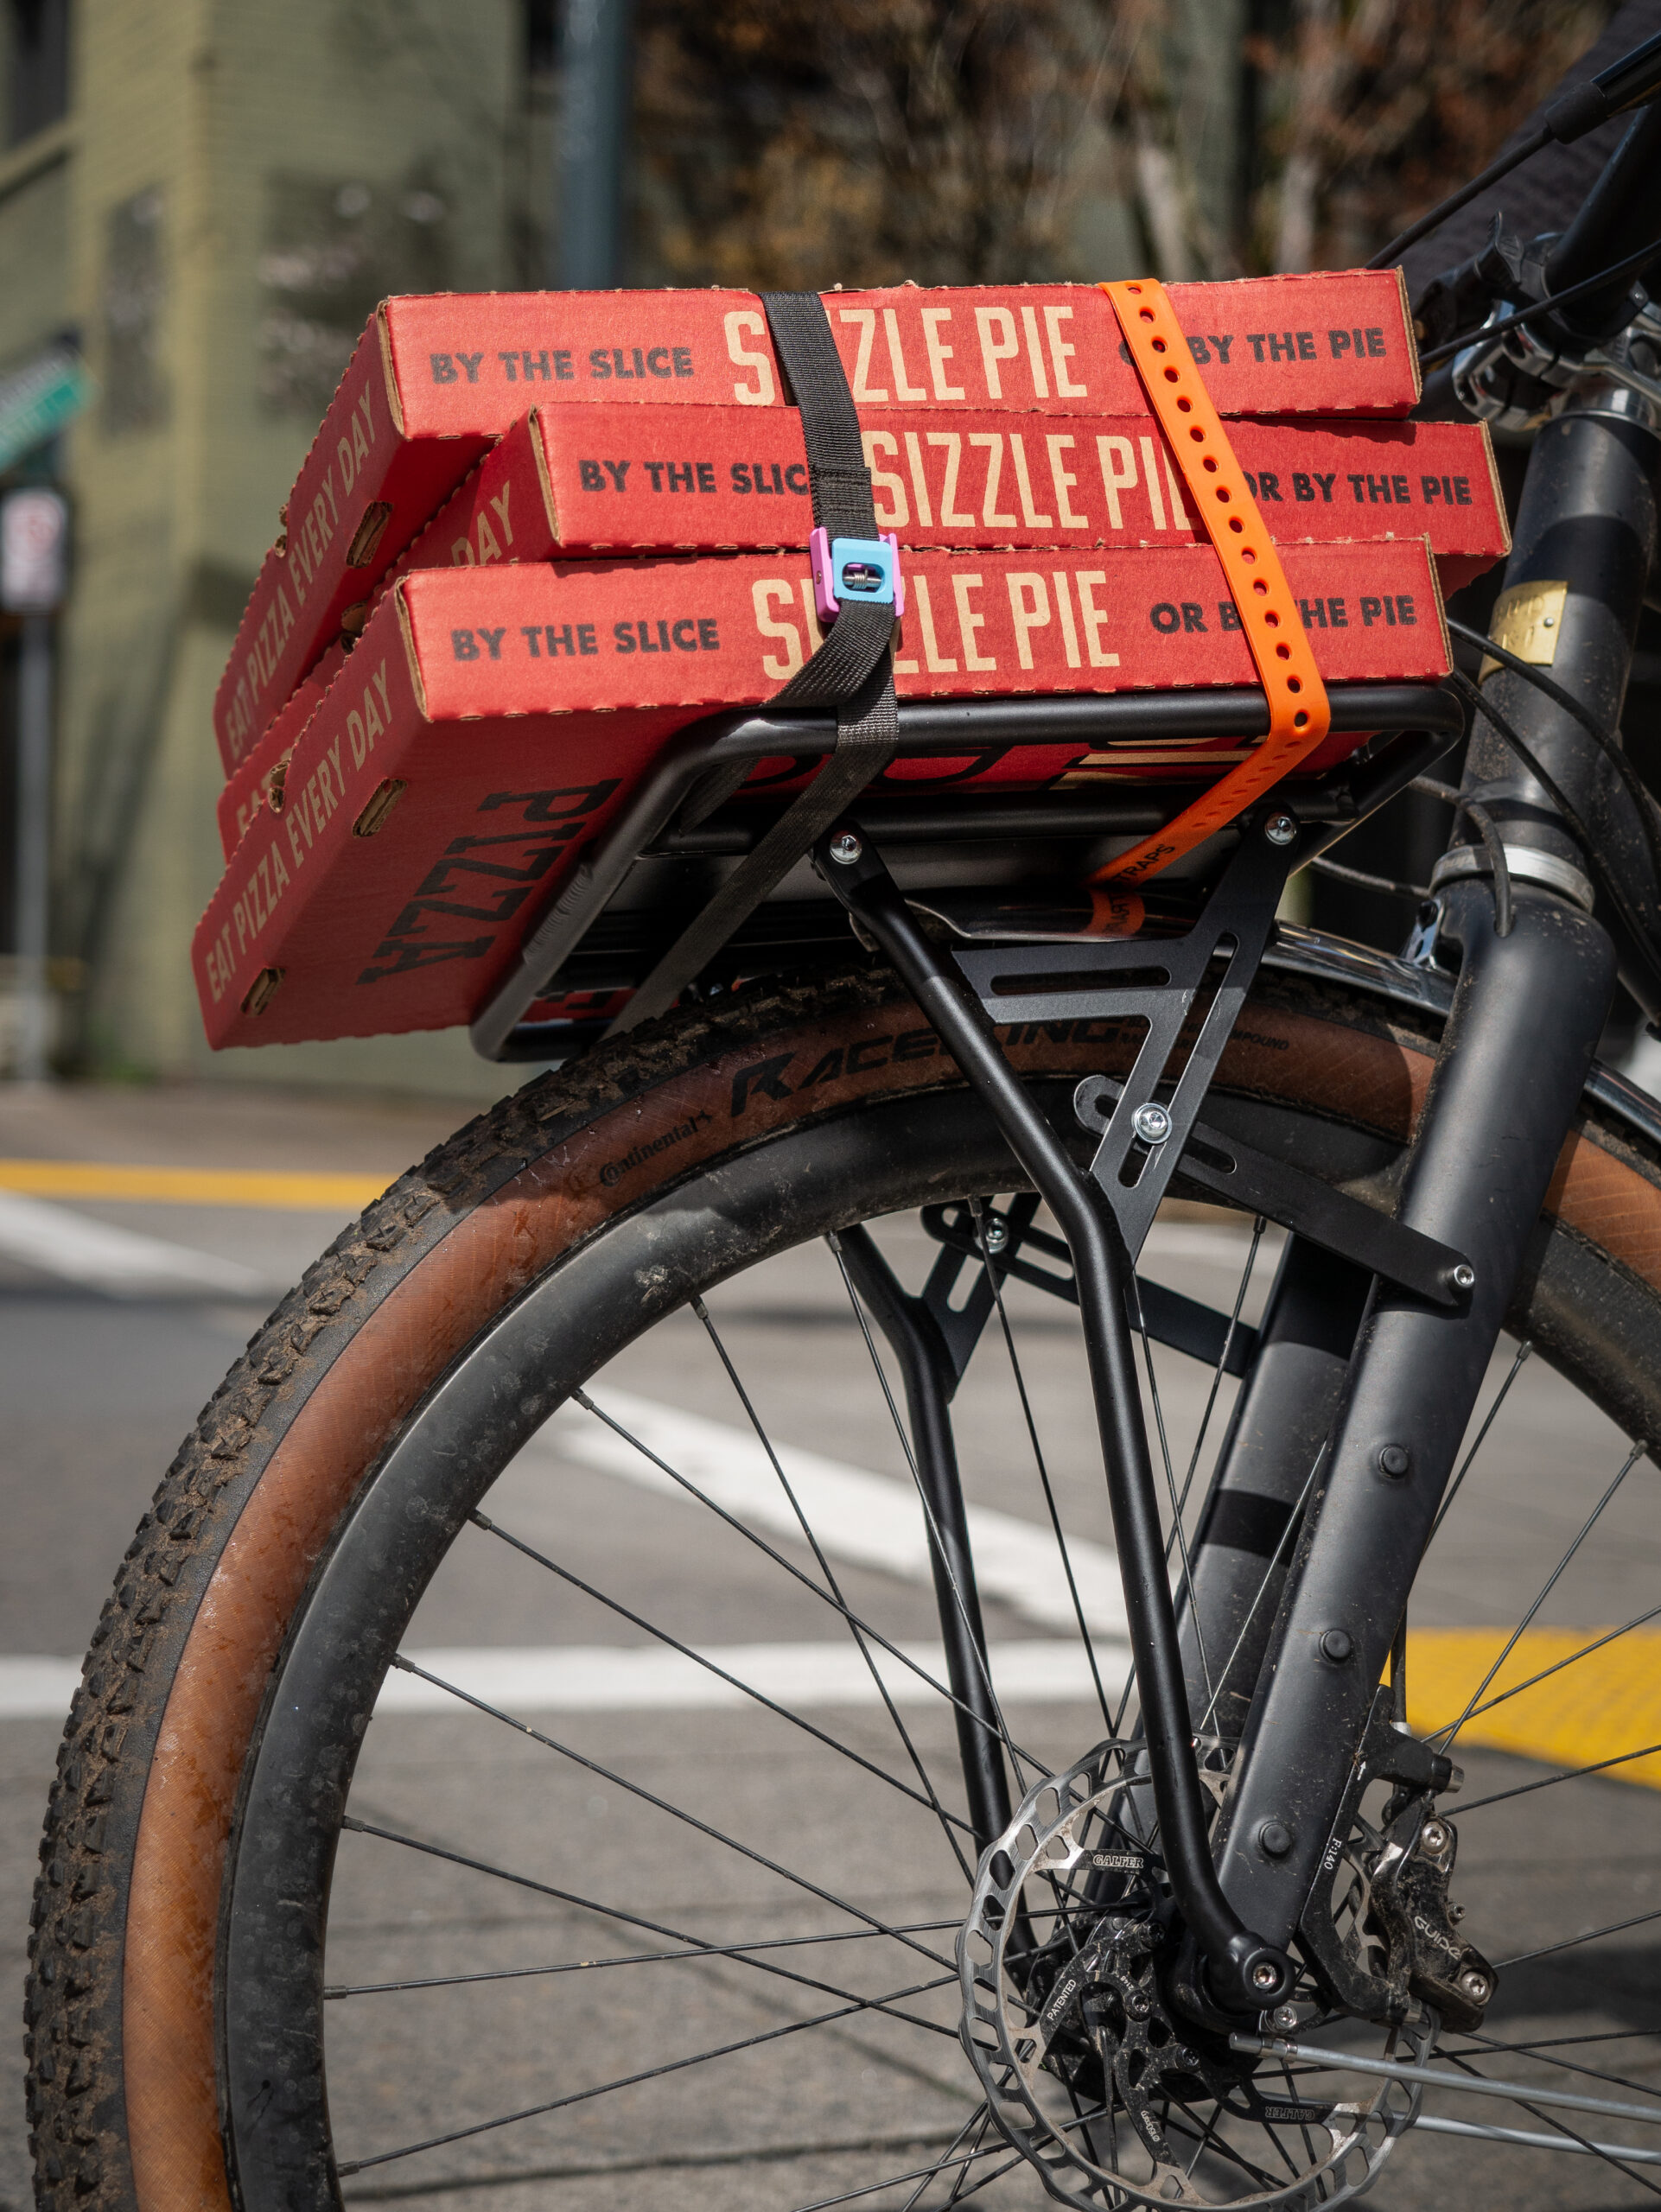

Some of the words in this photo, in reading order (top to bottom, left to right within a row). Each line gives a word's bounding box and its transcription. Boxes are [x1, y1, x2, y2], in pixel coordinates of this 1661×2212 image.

[430, 353, 485, 385] BY
[499, 349, 576, 381] THE
[589, 346, 695, 379] SLICE
[724, 308, 966, 405] SZLE
[974, 305, 1088, 401] PIE
[1186, 334, 1235, 365] BY
[1246, 332, 1318, 363] THE
[1328, 327, 1388, 359] PIE
[577, 459, 630, 493] BY
[644, 461, 716, 494] THE
[731, 462, 810, 496] SLIC
[860, 430, 1091, 529] SIZZLE
[1292, 472, 1338, 504] BY
[1347, 474, 1412, 505] THE
[1420, 474, 1474, 506] PIE
[450, 480, 513, 567] DAY
[226, 676, 257, 761] EAT
[245, 585, 296, 689] PIZZA
[288, 464, 340, 607] EVERY
[337, 382, 378, 498] DAY
[1006, 569, 1122, 671] PIE
[1149, 601, 1209, 635] OR
[1218, 601, 1243, 632] B
[1294, 597, 1349, 629] HE
[1359, 594, 1417, 627] PIE
[451, 626, 508, 662] BY
[519, 623, 600, 658] THE
[614, 618, 722, 653] SLICE
[205, 946, 237, 1004] EAT
[232, 840, 290, 956] PIZZA
[284, 734, 347, 869] EVERY
[346, 658, 392, 772] DAY
[354, 778, 624, 986] PIZZA
[1111, 842, 1176, 882] TRAPS
[599, 1116, 698, 1187] Continental
[1092, 1853, 1144, 1869] GALFER
[1414, 1916, 1461, 1961] GUIDE
[1047, 1978, 1078, 2022] PATENTED
